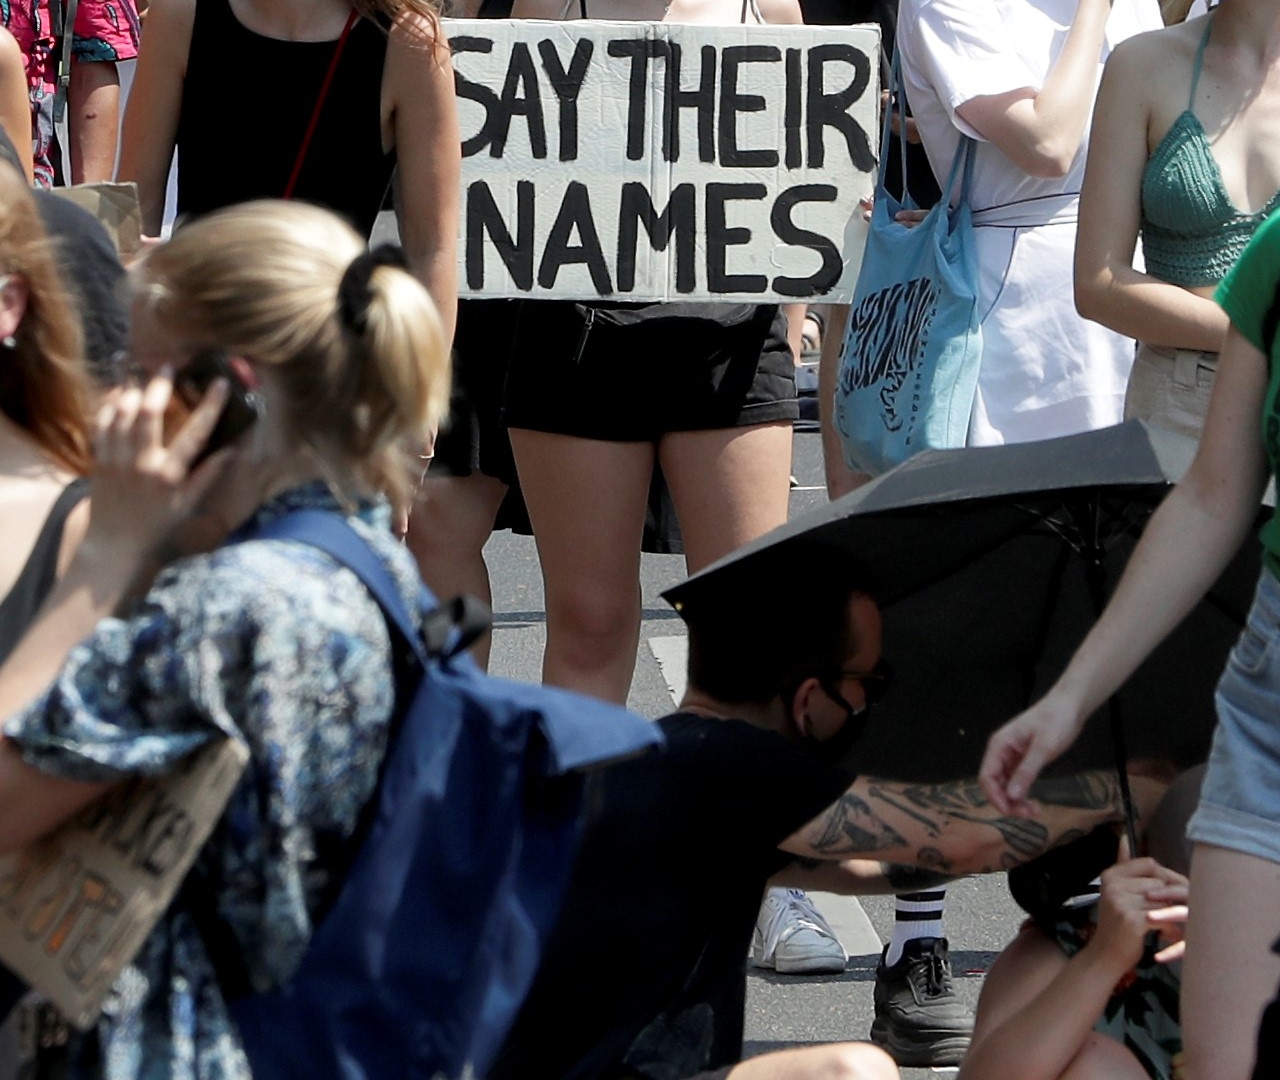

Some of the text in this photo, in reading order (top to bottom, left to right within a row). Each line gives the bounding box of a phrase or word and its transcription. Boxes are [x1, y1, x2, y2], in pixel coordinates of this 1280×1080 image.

[451, 36, 878, 173] SAY THEIR
[465, 179, 844, 296] NAMES
